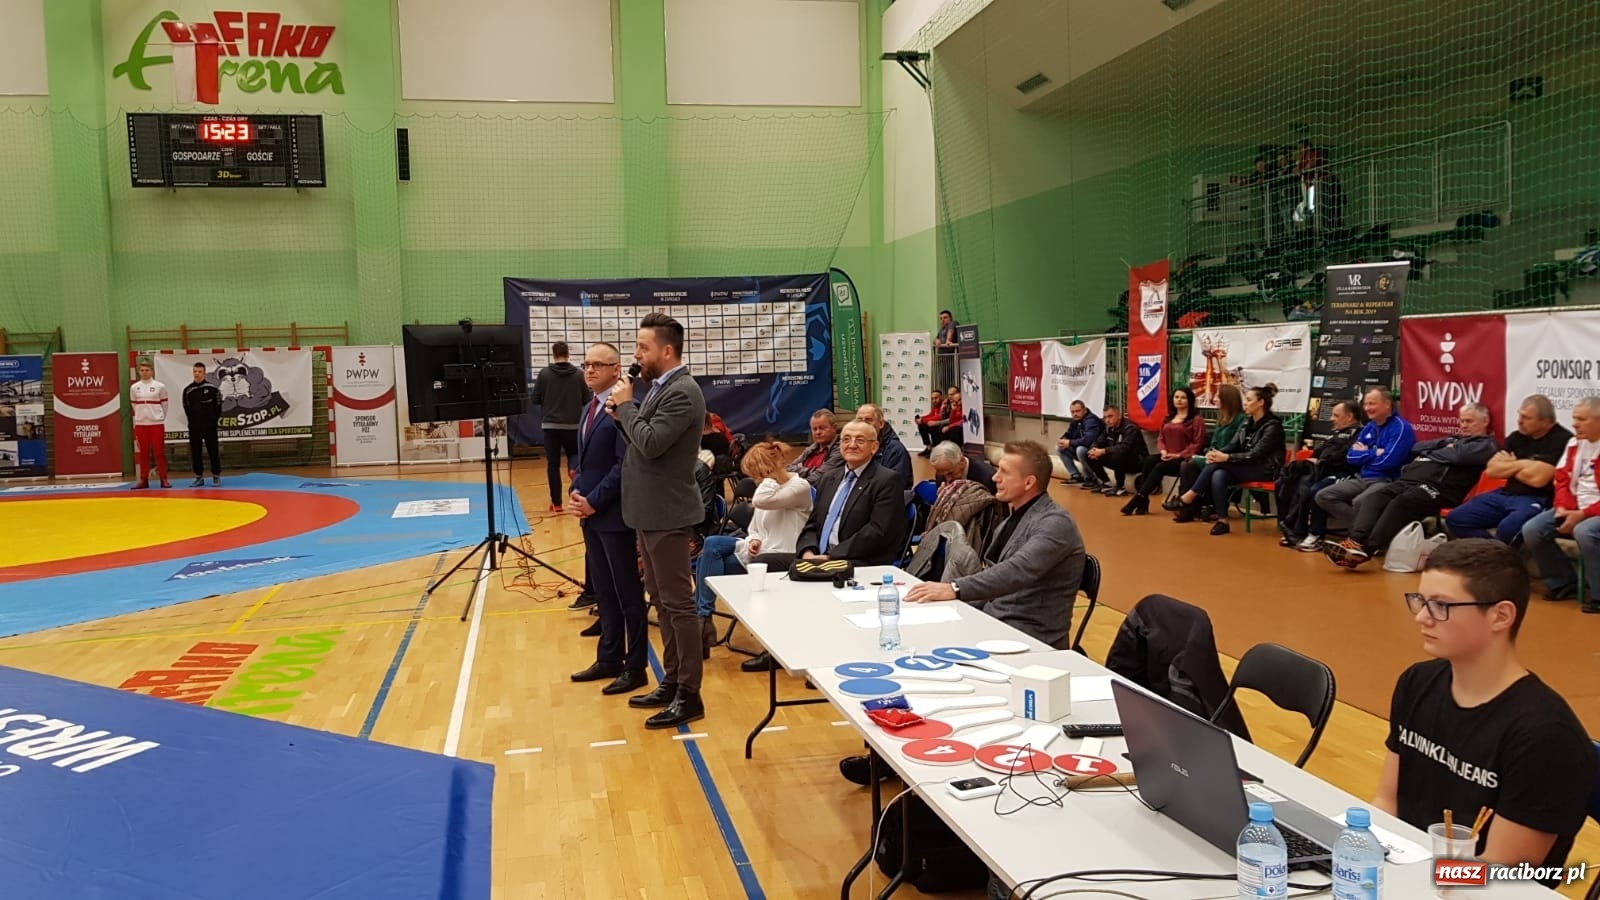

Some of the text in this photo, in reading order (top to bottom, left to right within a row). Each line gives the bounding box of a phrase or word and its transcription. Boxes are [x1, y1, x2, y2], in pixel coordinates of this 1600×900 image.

[204, 123, 249, 140] 15:23
[172, 151, 221, 161] GOSPODARZE
[247, 148, 274, 161] GOŚCIE
[1348, 274, 1362, 286] VR
[346, 368, 380, 380] PWPW
[1537, 359, 1593, 380] SPONSOR
[68, 375, 104, 389] PWPW
[1014, 375, 1037, 392] PWPW
[1418, 380, 1484, 411] PWPW
[1420, 414, 1441, 423] POLSKA
[993, 747, 1036, 767] 2
[1072, 755, 1103, 773] 1
[1457, 761, 1499, 789] JEANS
